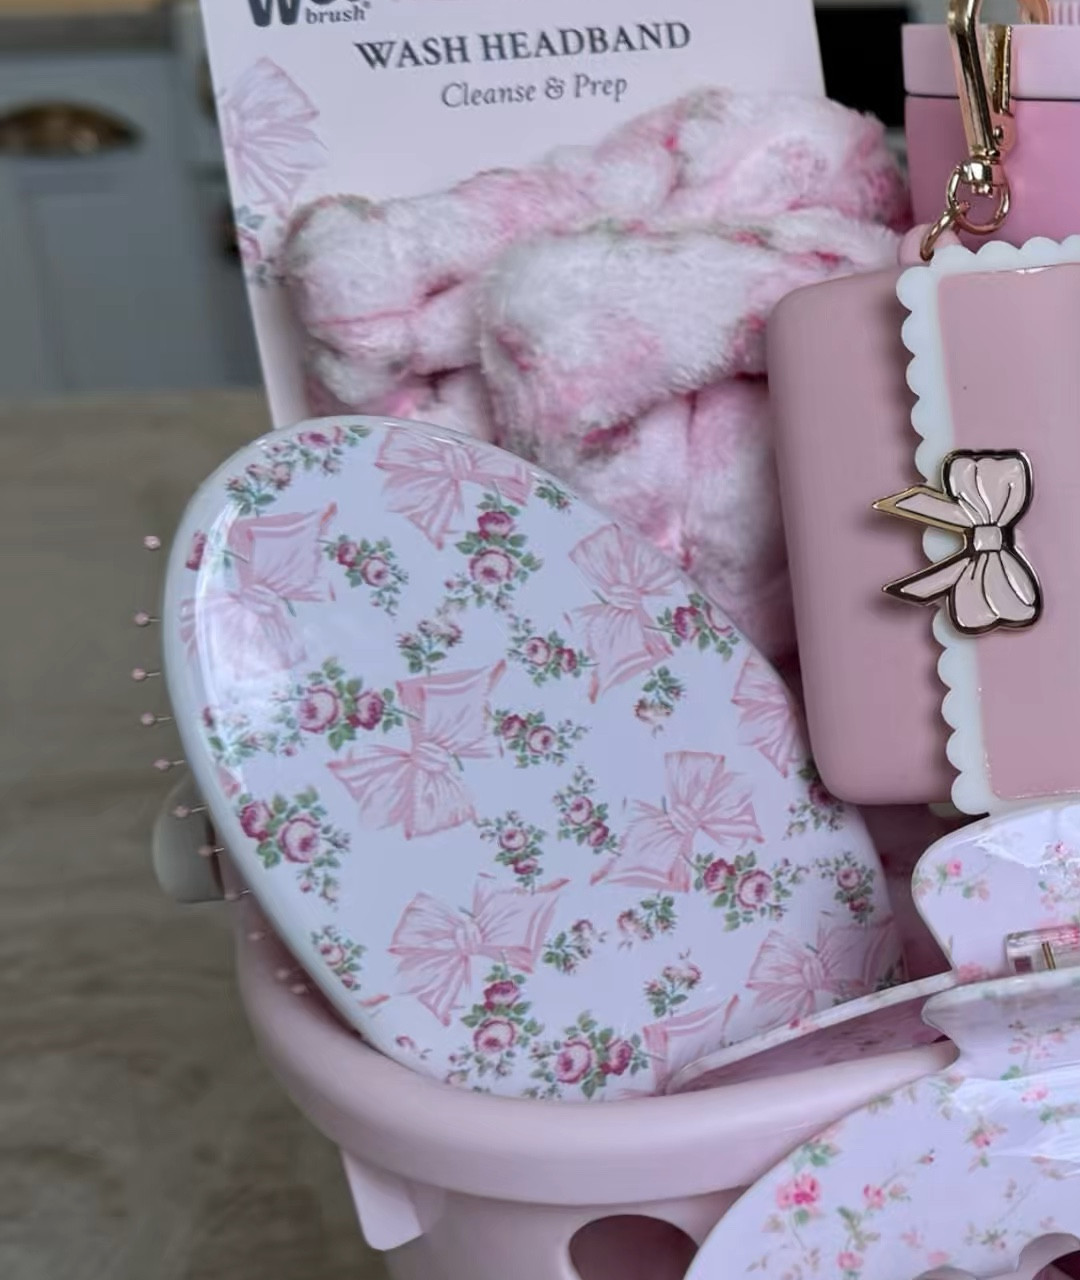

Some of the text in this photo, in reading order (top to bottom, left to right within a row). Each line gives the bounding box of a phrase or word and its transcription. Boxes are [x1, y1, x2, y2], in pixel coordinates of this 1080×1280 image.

[353, 21, 691, 69] WASH HEADBAND
[440, 72, 629, 108] Cleanse & Prep
